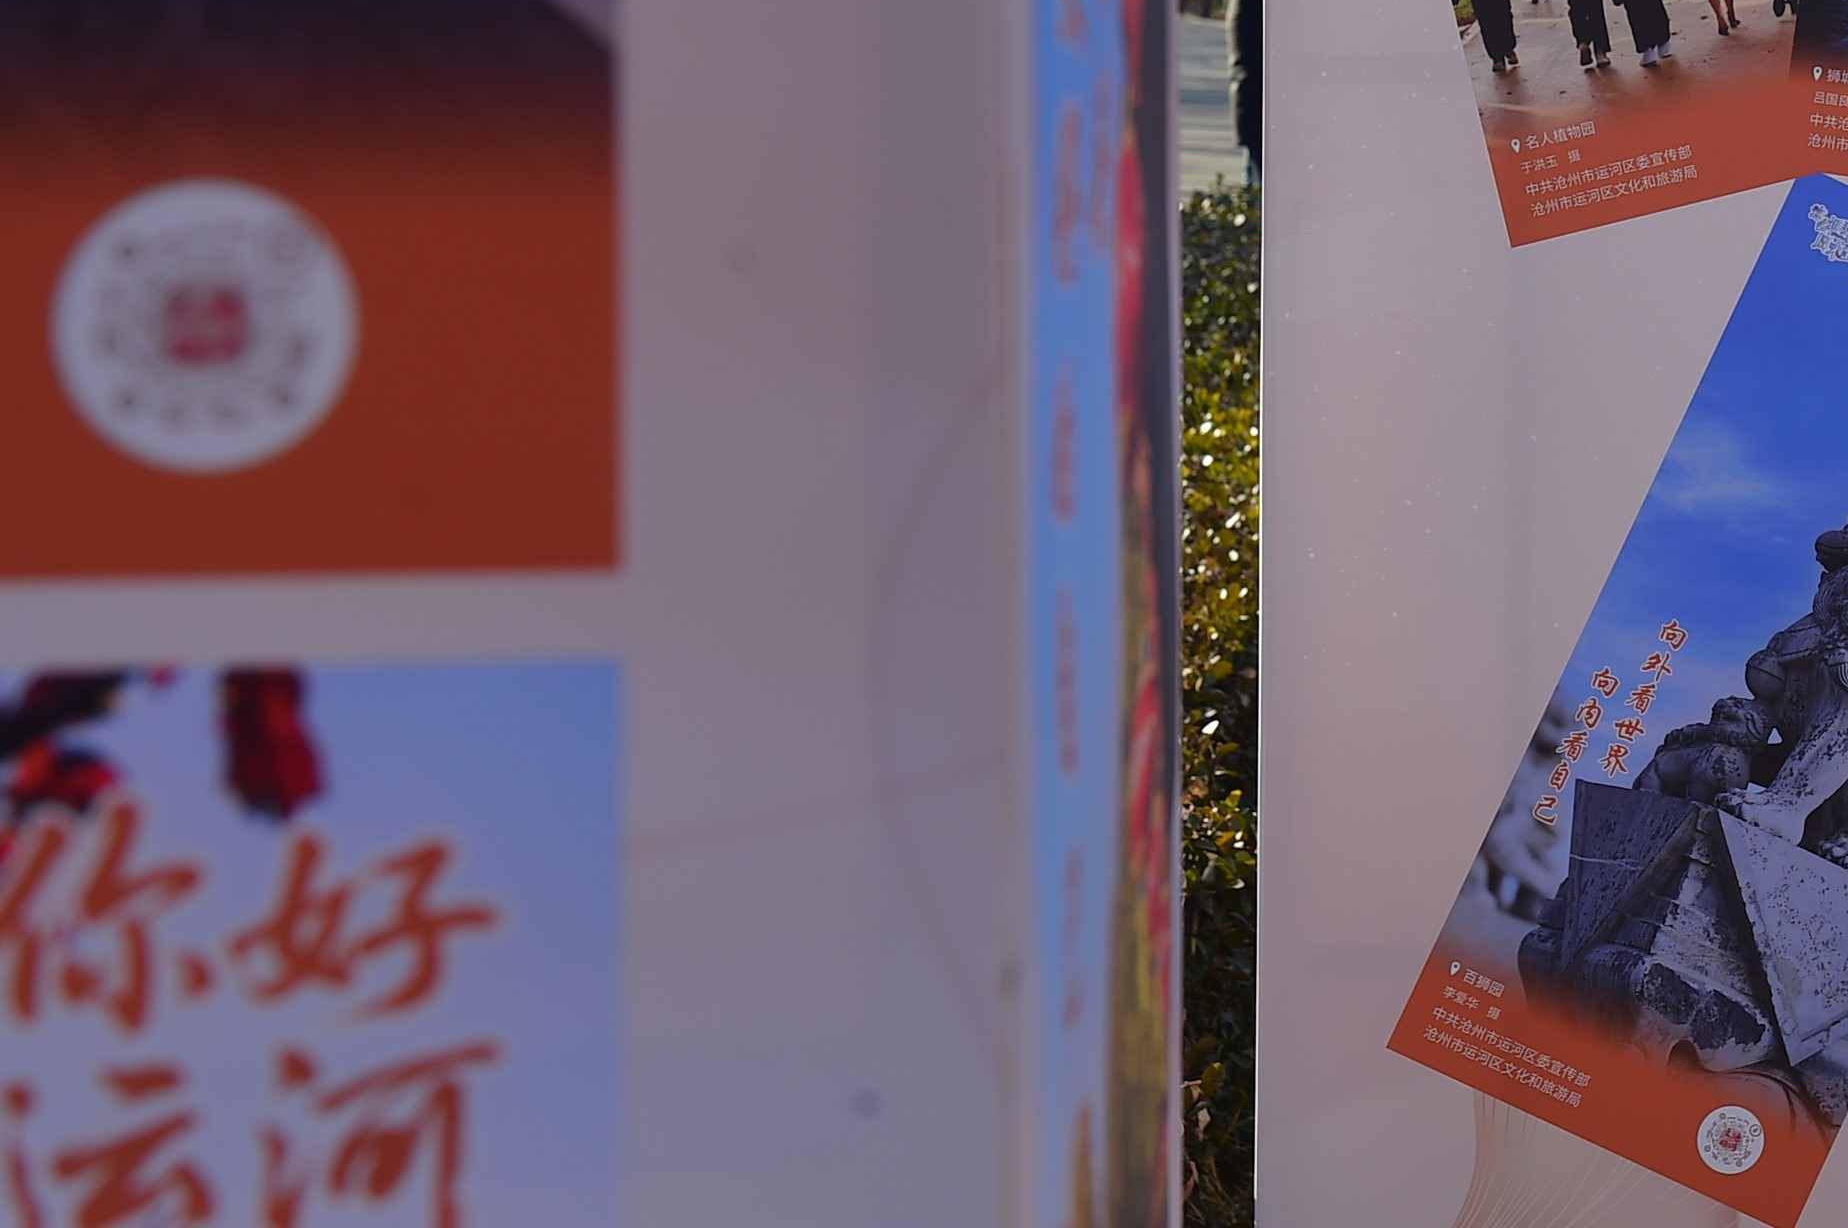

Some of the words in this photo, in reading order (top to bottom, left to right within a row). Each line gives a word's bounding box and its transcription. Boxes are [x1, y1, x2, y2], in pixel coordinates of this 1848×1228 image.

[1525, 121, 1596, 150] 名人植物园
[1526, 145, 1692, 196] 中共沧州市运河区委宣传部
[1531, 165, 1697, 217] 沧州市运河区文化和旅游局
[1599, 618, 1689, 778] 向外看世界
[1532, 667, 1622, 825] 向内看自己
[0, 802, 500, 1034] 你好
[1423, 1025, 1582, 1107] 沧州市运河区文化和旅游局
[1433, 1006, 1591, 1087] 中共沧州市运河区委宣传部
